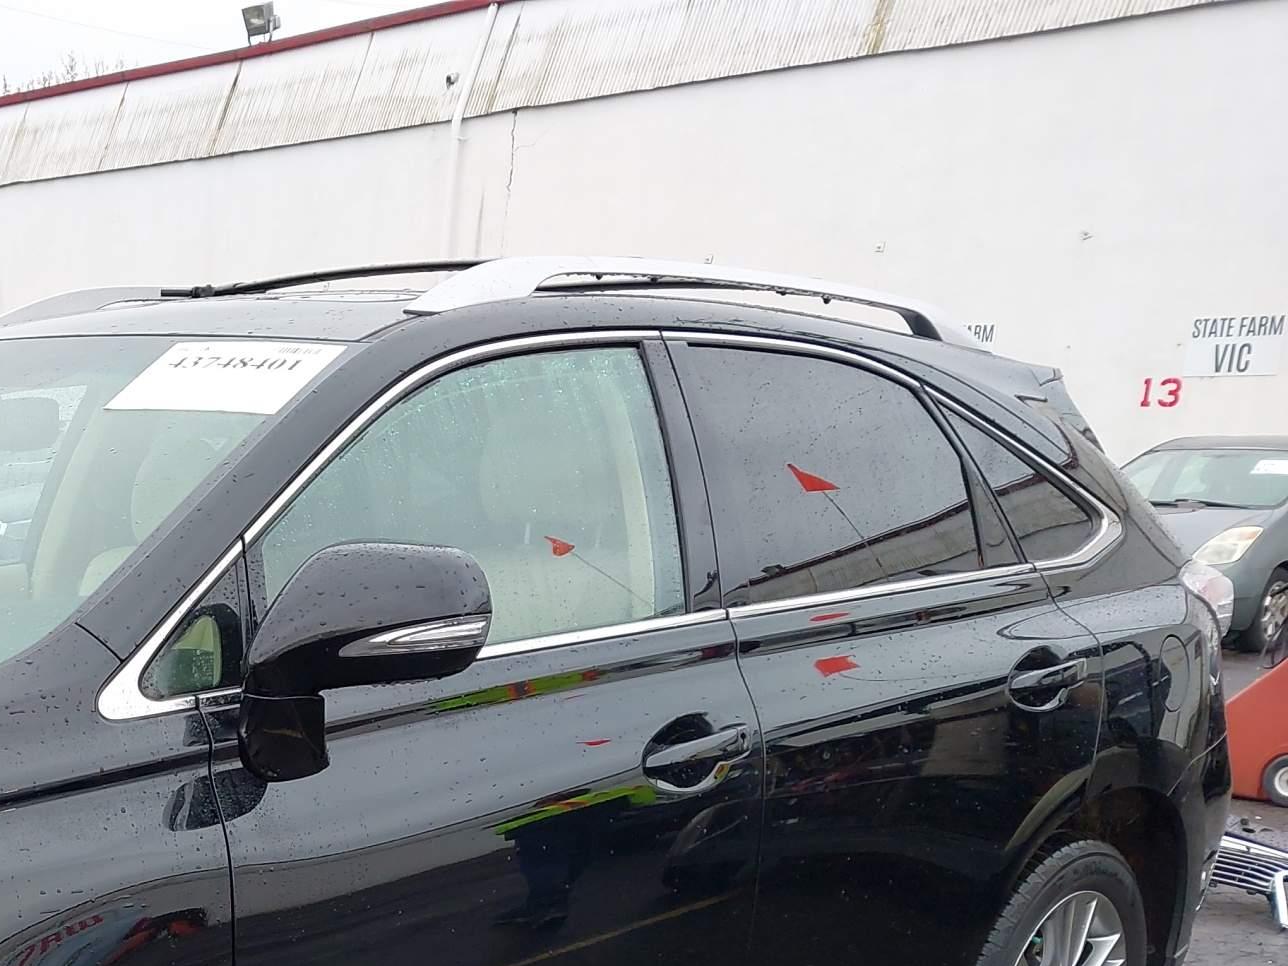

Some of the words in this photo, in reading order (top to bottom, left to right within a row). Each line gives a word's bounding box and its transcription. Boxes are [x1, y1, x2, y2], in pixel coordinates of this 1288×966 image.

[1192, 317, 1236, 339] STATE
[1238, 315, 1286, 337] FARM
[168, 356, 302, 371] 43748401
[1214, 343, 1252, 373] VIC
[1140, 377, 1183, 407] 13
